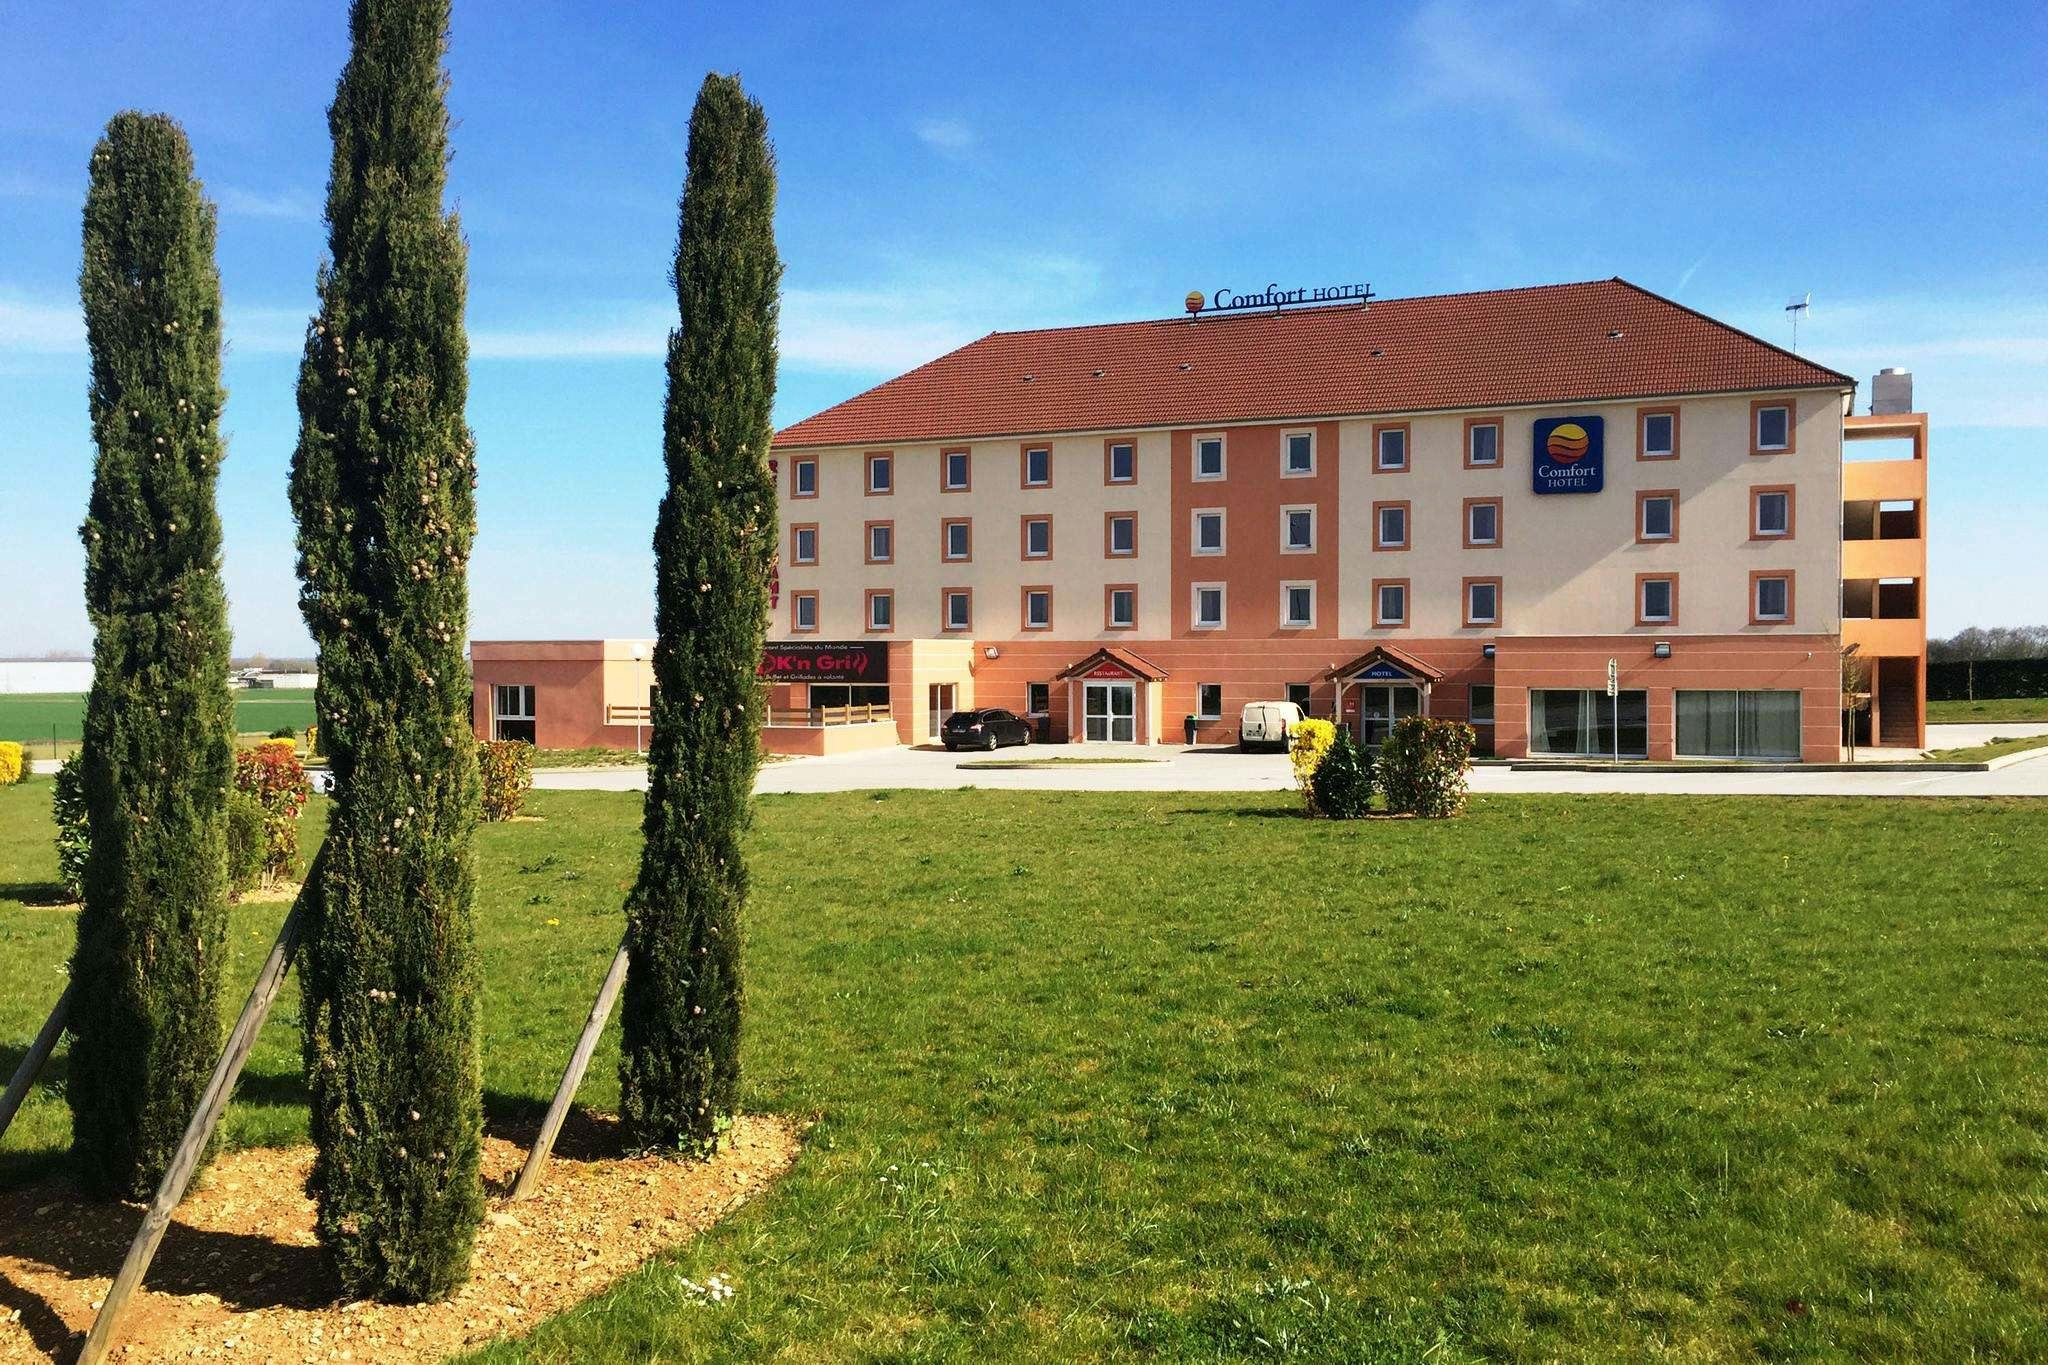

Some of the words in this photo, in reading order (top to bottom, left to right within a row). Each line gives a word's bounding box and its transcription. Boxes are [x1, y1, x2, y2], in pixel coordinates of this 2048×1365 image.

[1214, 284, 1306, 309] Comfort
[1314, 283, 1371, 300] HOTEL
[1538, 464, 1597, 478] Comfort
[1548, 478, 1587, 487] HOTEL
